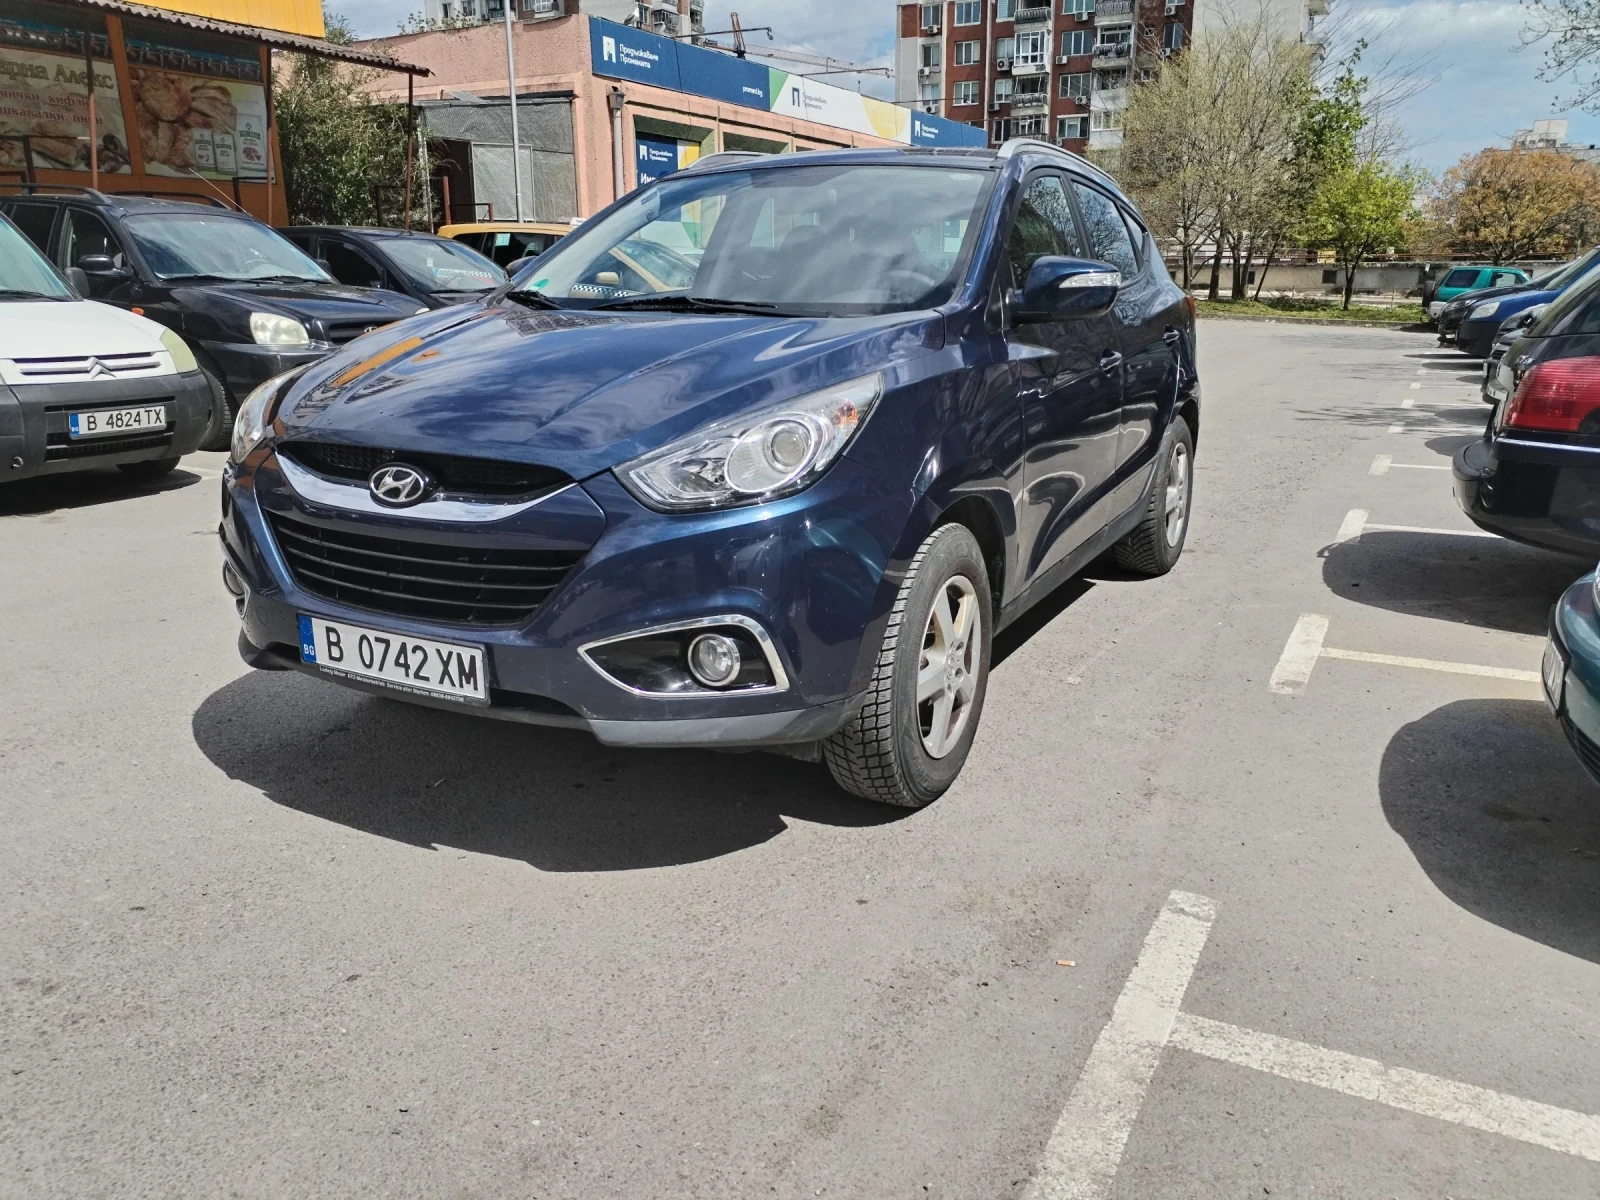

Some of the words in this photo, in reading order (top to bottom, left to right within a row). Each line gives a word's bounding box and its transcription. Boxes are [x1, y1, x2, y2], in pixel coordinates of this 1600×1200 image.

[620, 53, 651, 68] Промяната
[54, 64, 114, 89] Алекс
[86, 415, 97, 431] B
[106, 410, 141, 429] 4824
[144, 408, 162, 425] TX
[303, 644, 315, 656] BG
[325, 625, 344, 663] B
[358, 633, 430, 682] 0742
[435, 648, 478, 691] XM
